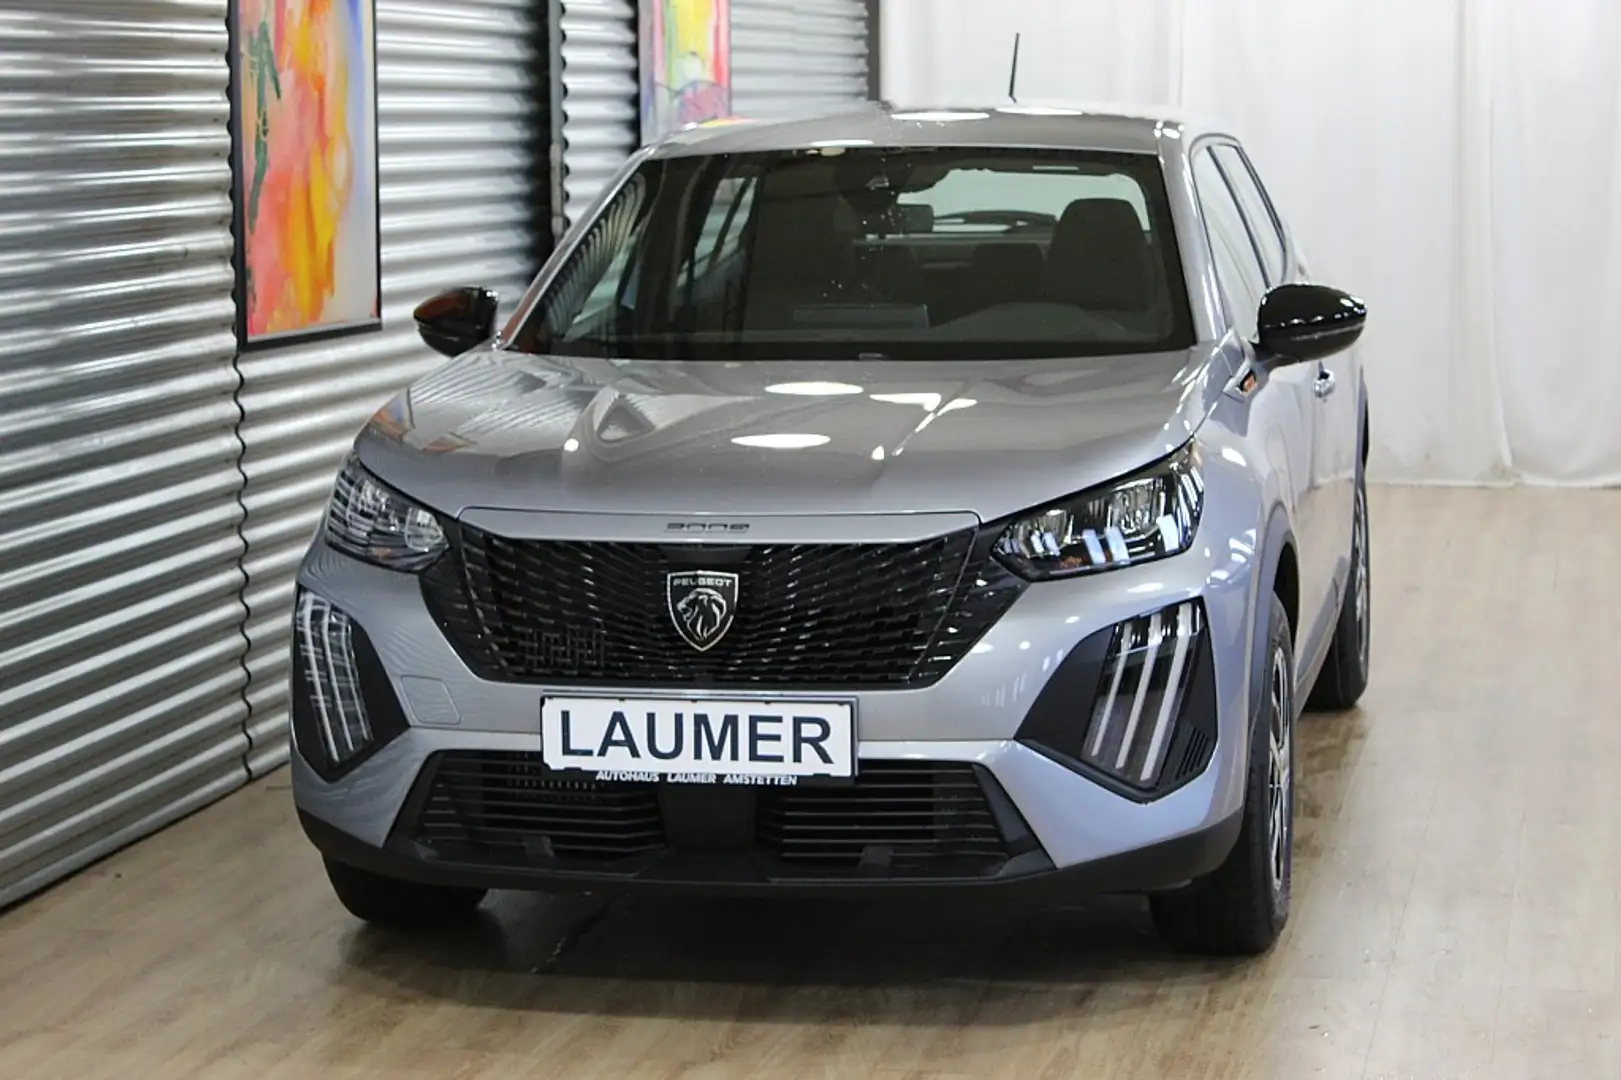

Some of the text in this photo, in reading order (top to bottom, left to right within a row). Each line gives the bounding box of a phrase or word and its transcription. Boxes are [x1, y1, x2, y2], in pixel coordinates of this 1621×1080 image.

[673, 577, 732, 587] PEUGEOT
[560, 710, 834, 764] LAUMER
[595, 770, 798, 786] AUTOHAUS LAUMER AMSTETTEN
